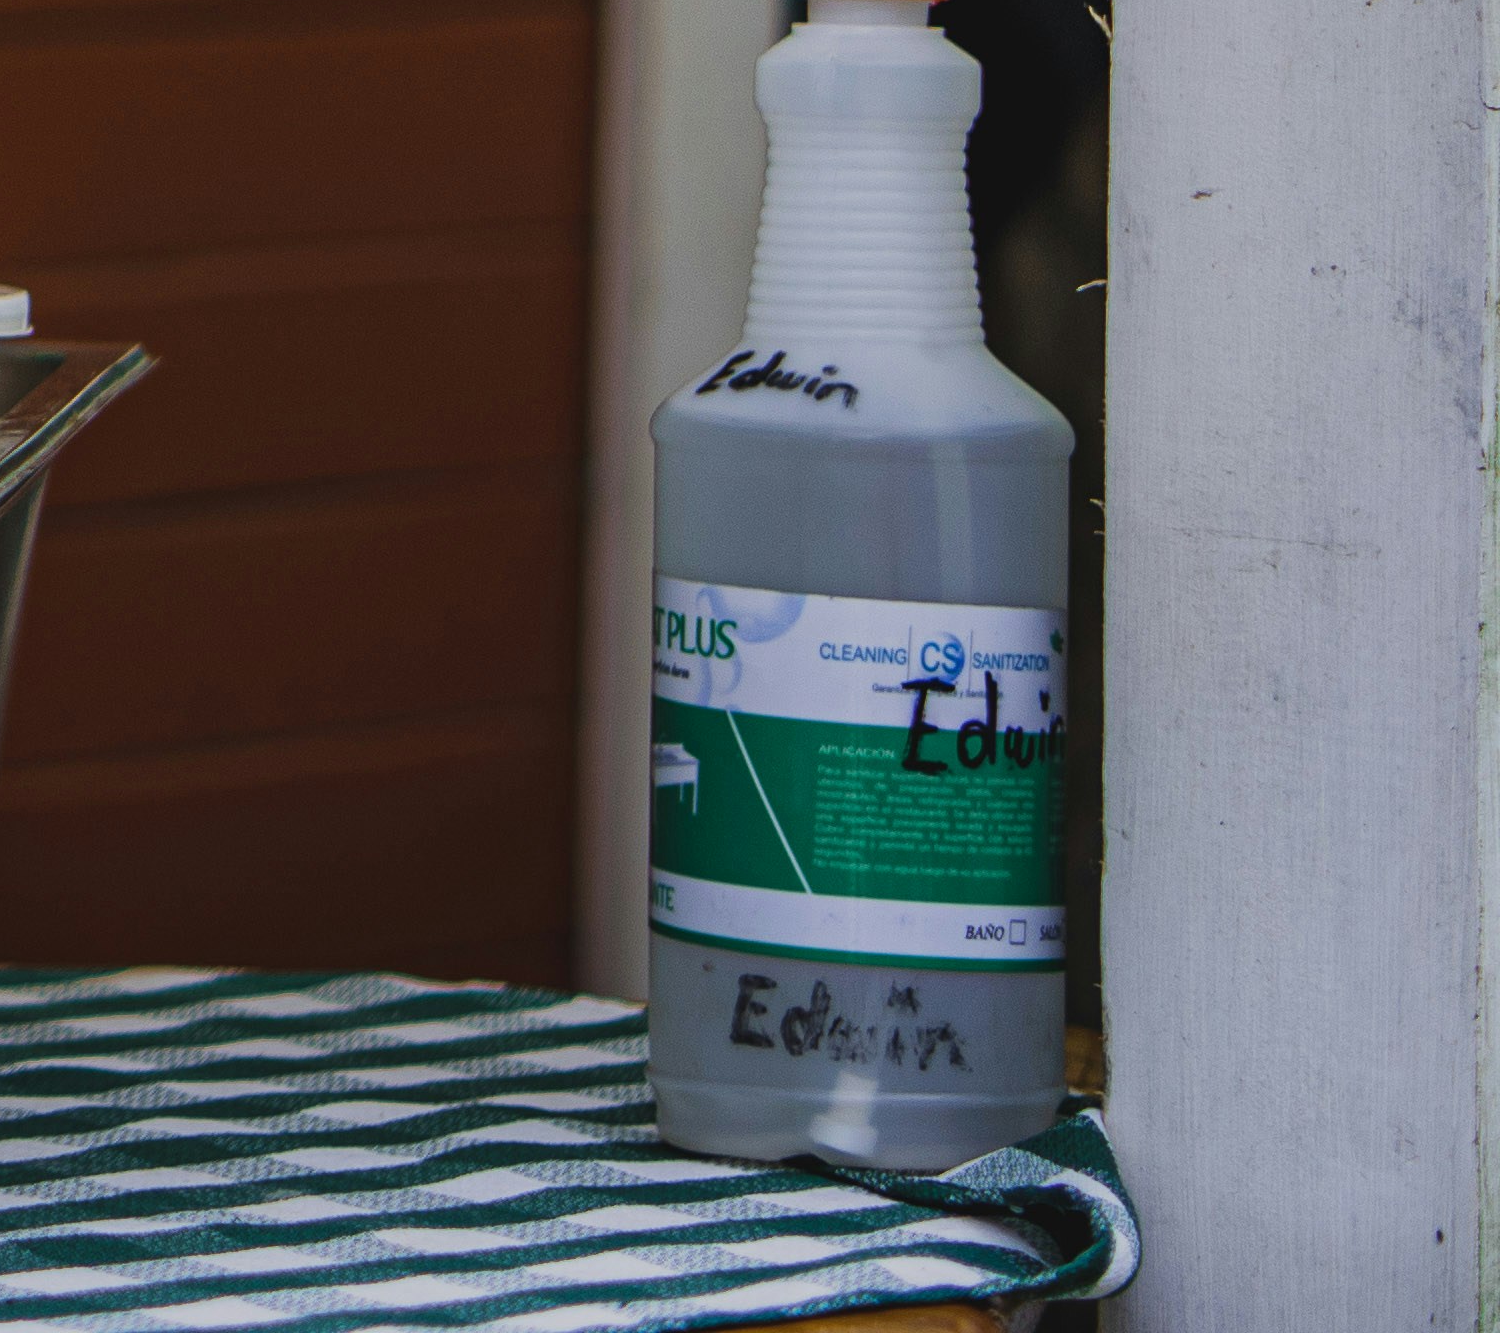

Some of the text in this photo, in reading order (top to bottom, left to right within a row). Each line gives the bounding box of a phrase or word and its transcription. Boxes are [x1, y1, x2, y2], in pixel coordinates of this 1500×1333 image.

[695, 349, 858, 409] Edwin
[667, 610, 738, 660] PLUS
[819, 640, 1050, 674] CLEANING CS SANITIZATION
[901, 670, 1066, 774] Edwin
[965, 922, 1005, 941] BAÑO
[729, 972, 974, 1072] Edwin
